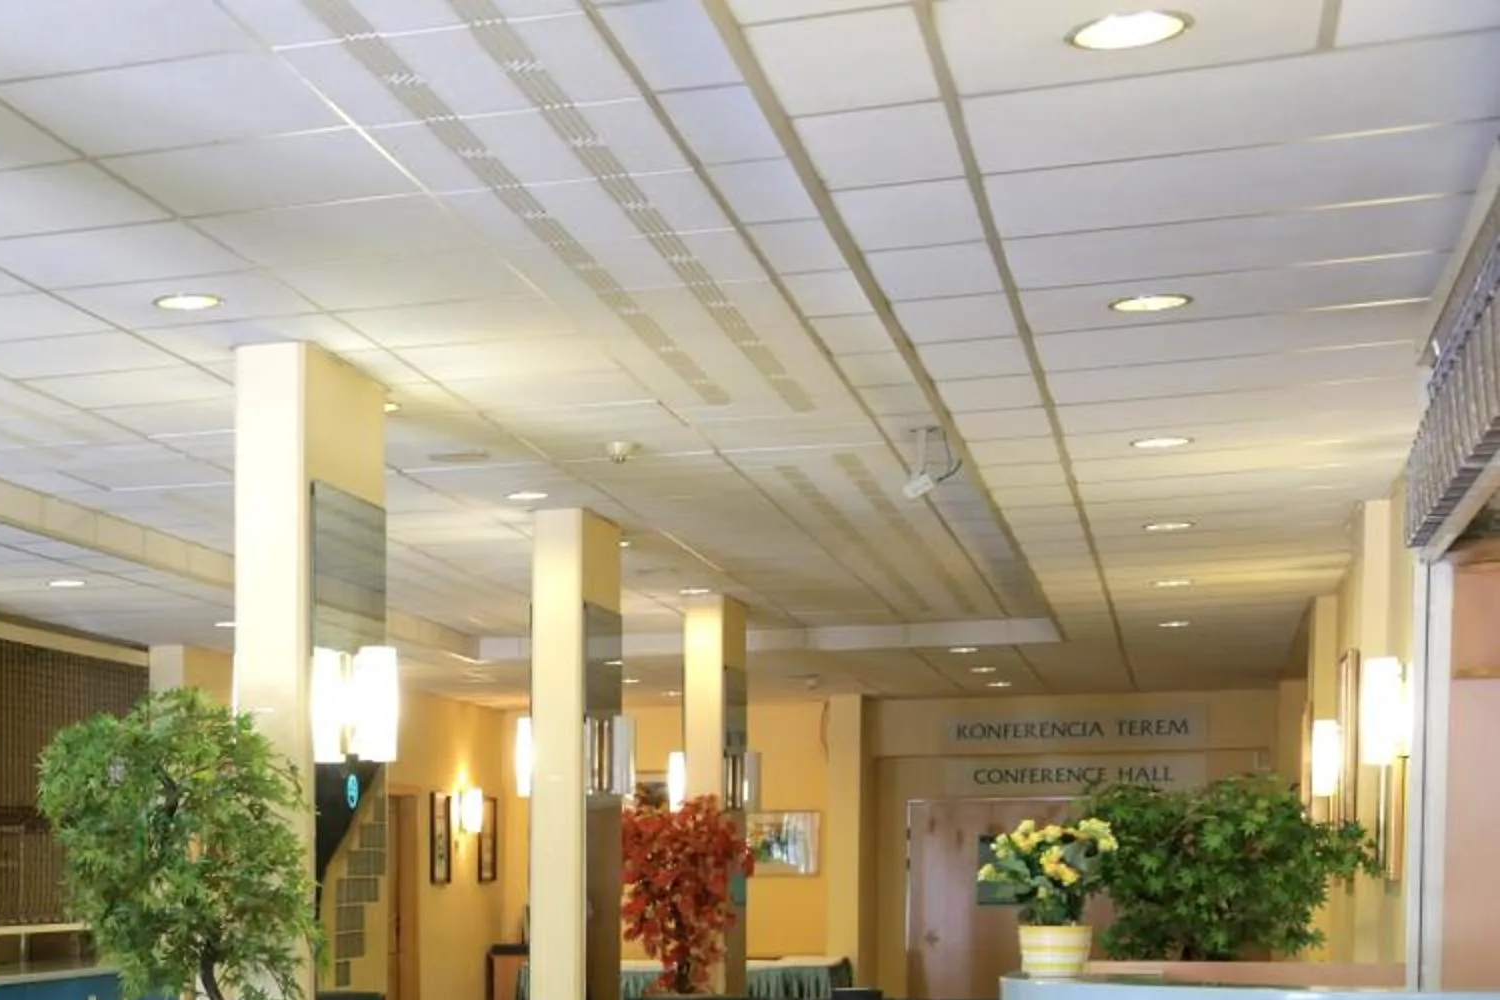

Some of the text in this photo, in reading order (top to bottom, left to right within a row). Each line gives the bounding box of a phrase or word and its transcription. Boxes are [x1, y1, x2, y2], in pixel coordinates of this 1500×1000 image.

[956, 718, 1190, 740] KONFERENCIA TEREM
[973, 765, 1174, 785] CONFERENCE HALL
